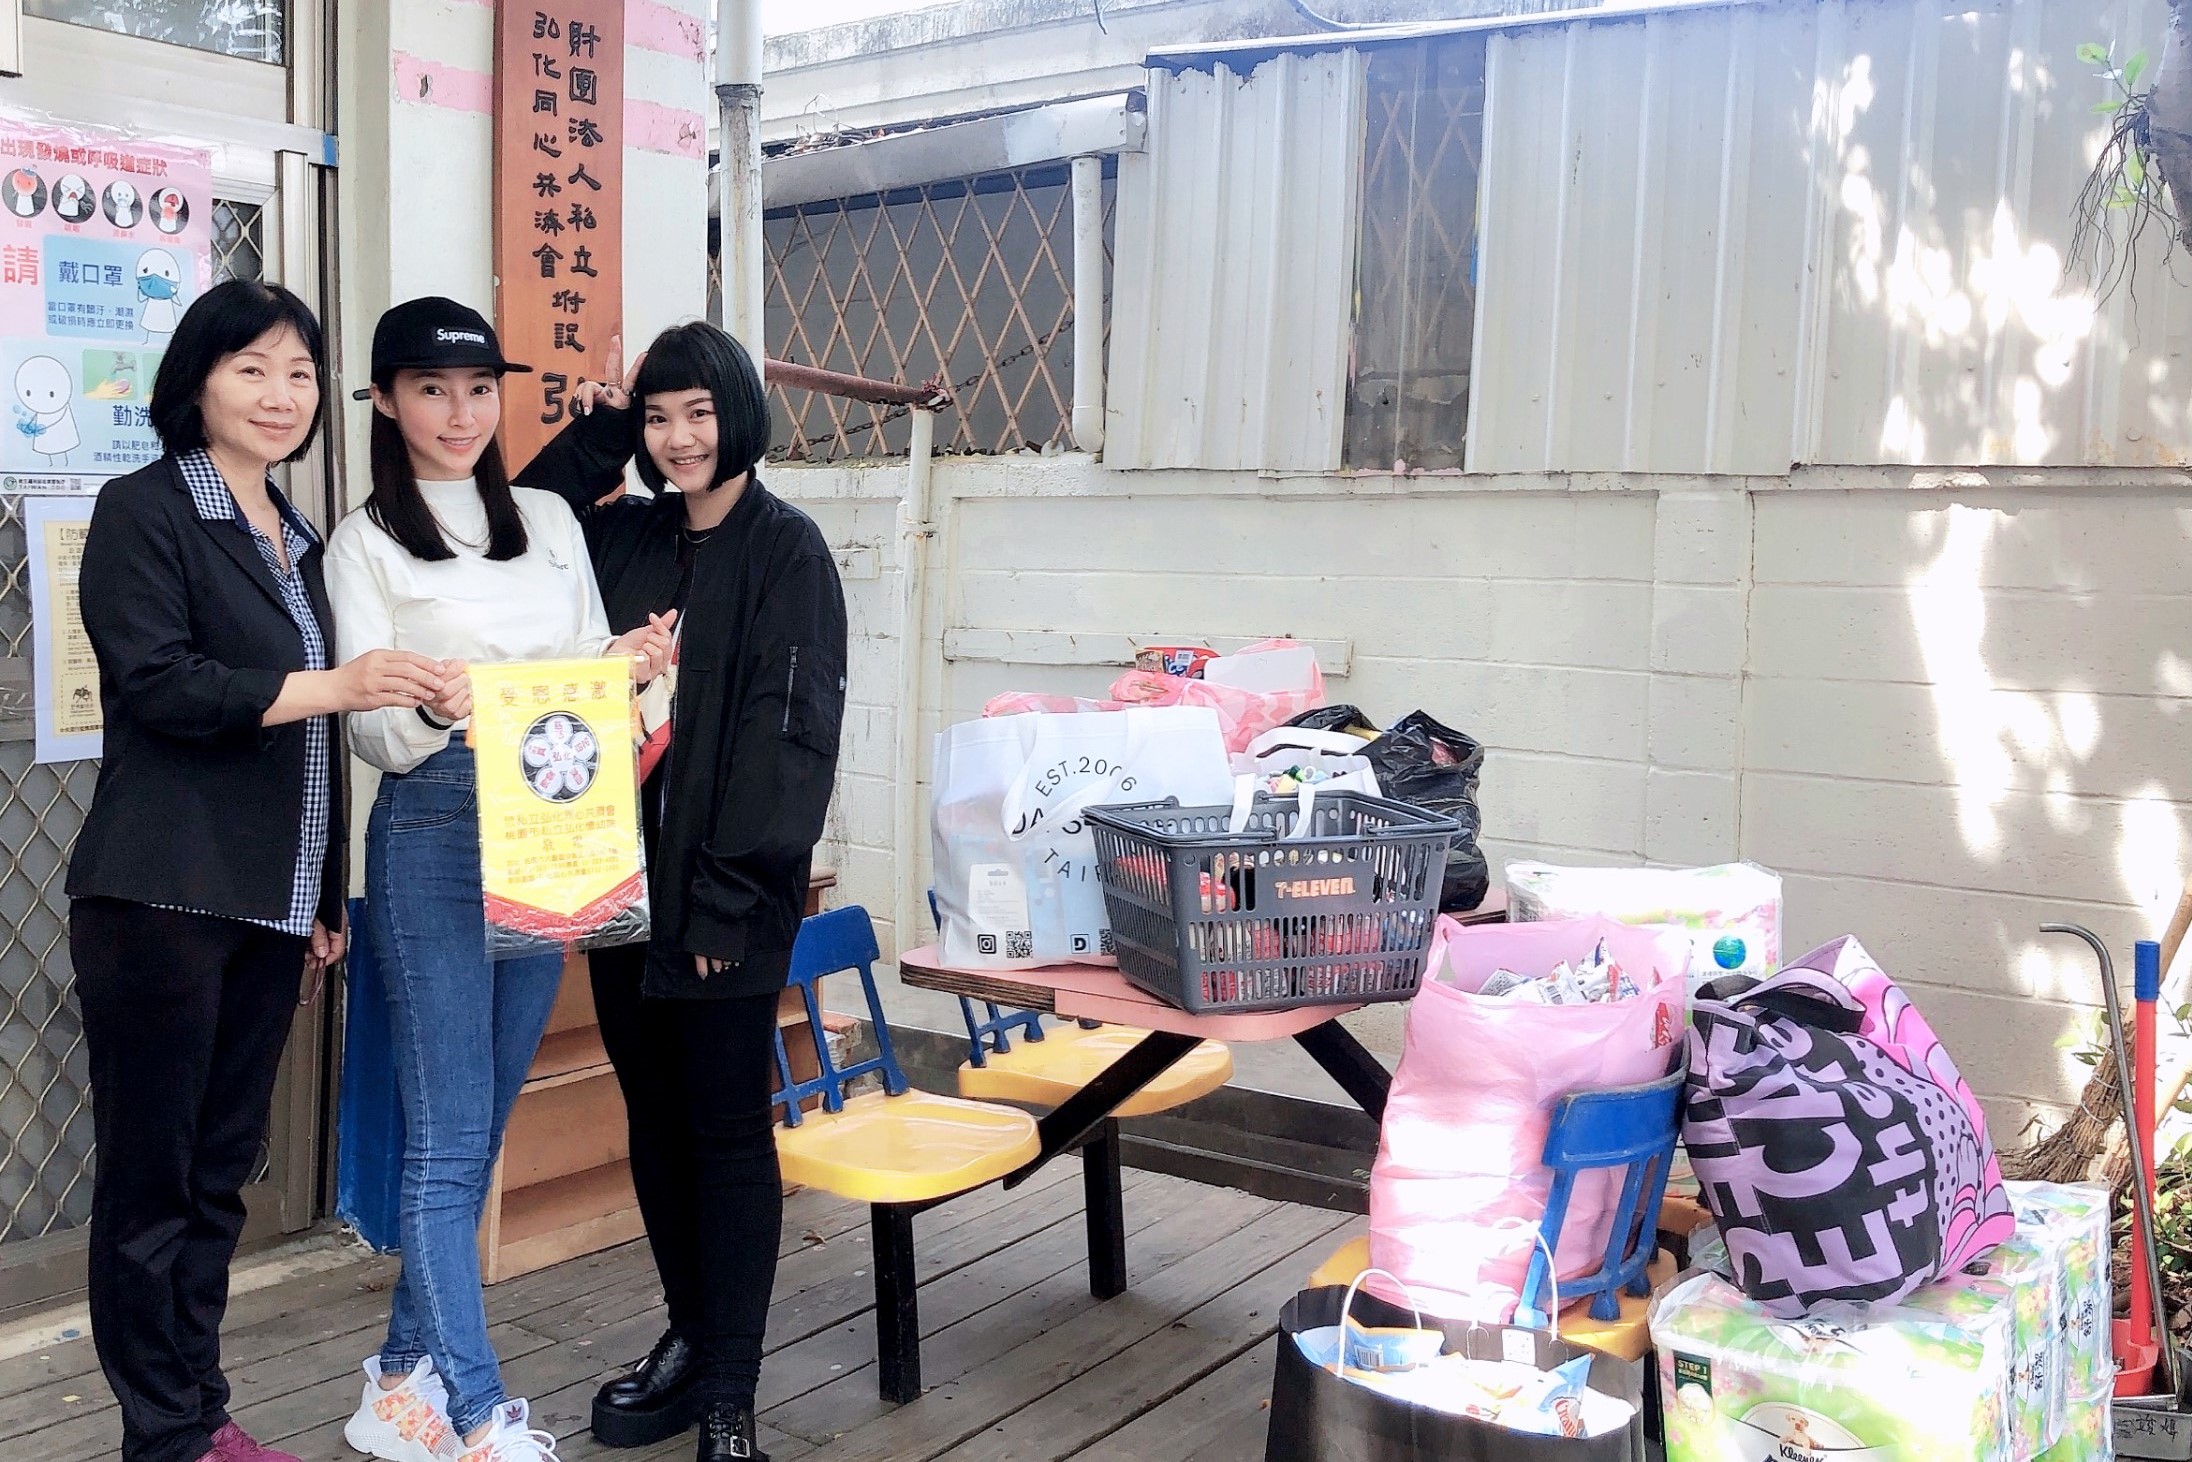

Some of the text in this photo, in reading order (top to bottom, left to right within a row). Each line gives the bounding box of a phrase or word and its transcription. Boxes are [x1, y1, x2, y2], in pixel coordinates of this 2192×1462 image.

[532, 11, 565, 278] 弘化同心共濟會
[2, 244, 39, 286] 請
[58, 260, 124, 287] 戴口罩
[436, 328, 486, 344] Supreme
[1677, 1359, 1701, 1372] STEP
[1702, 1366, 1708, 1375] 1
